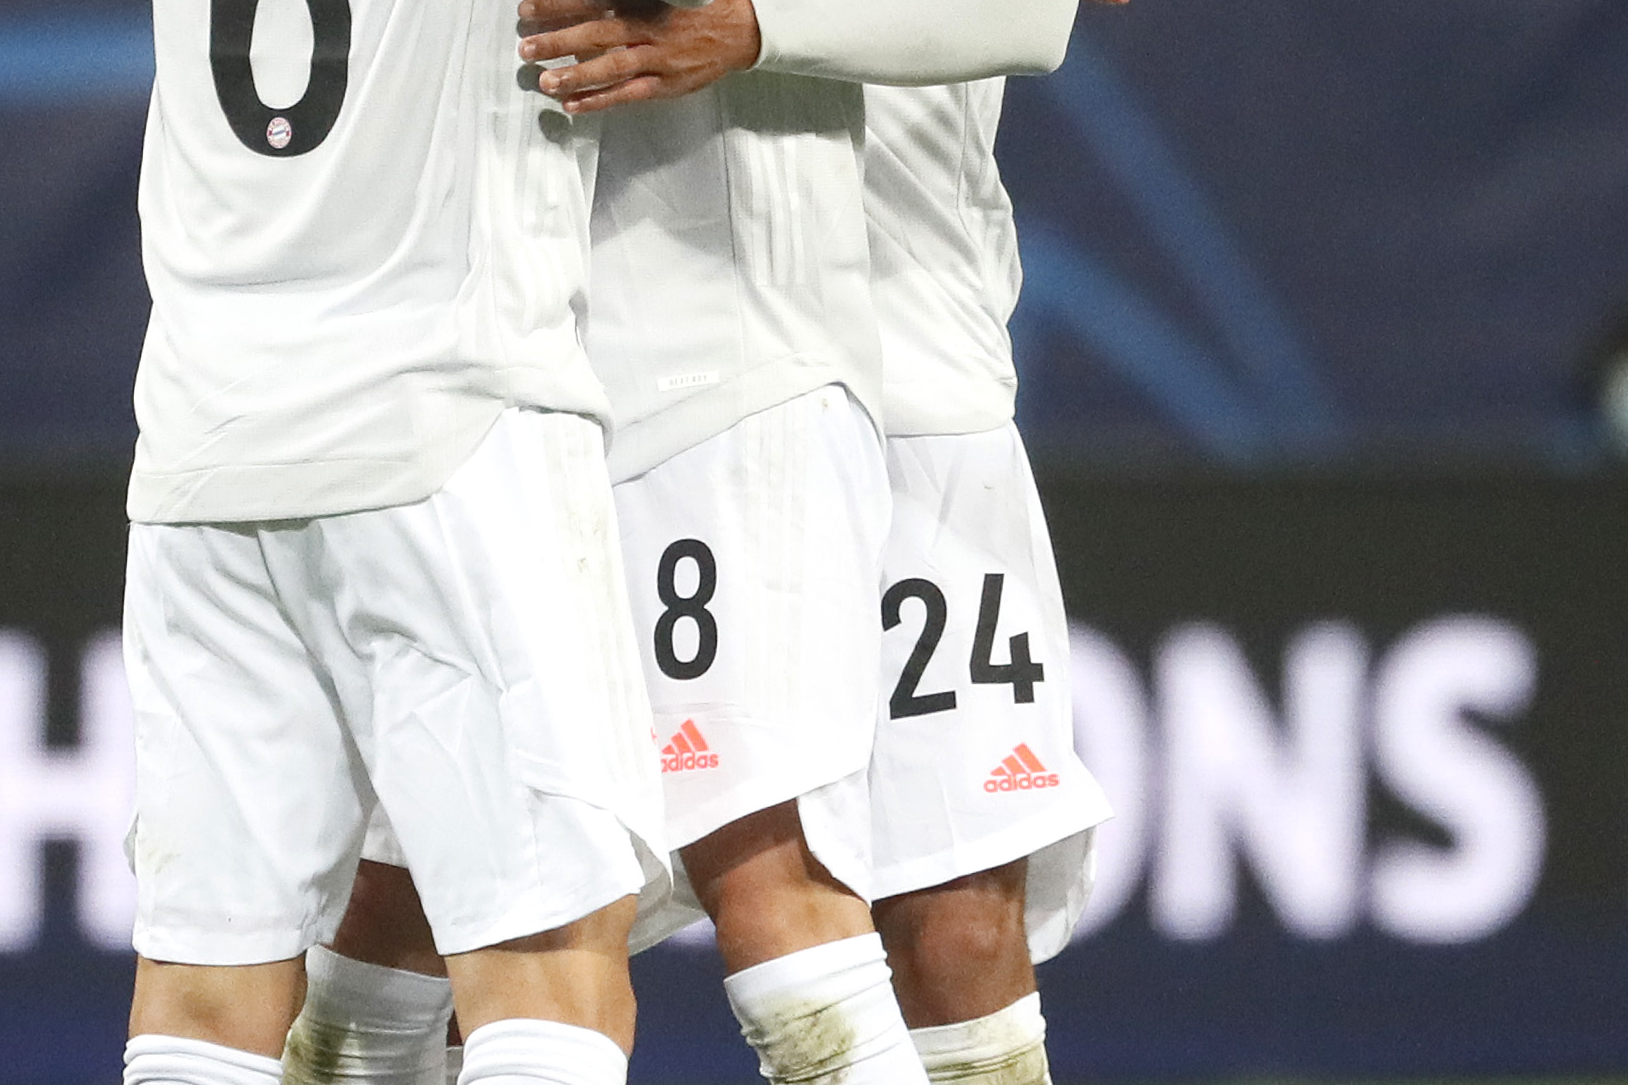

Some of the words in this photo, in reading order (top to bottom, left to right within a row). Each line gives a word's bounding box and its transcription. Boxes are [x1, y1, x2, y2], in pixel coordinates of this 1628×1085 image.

[654, 538, 718, 680] 8
[880, 573, 1045, 720] 24
[661, 752, 719, 773] adidas
[983, 772, 1060, 793] adidas
